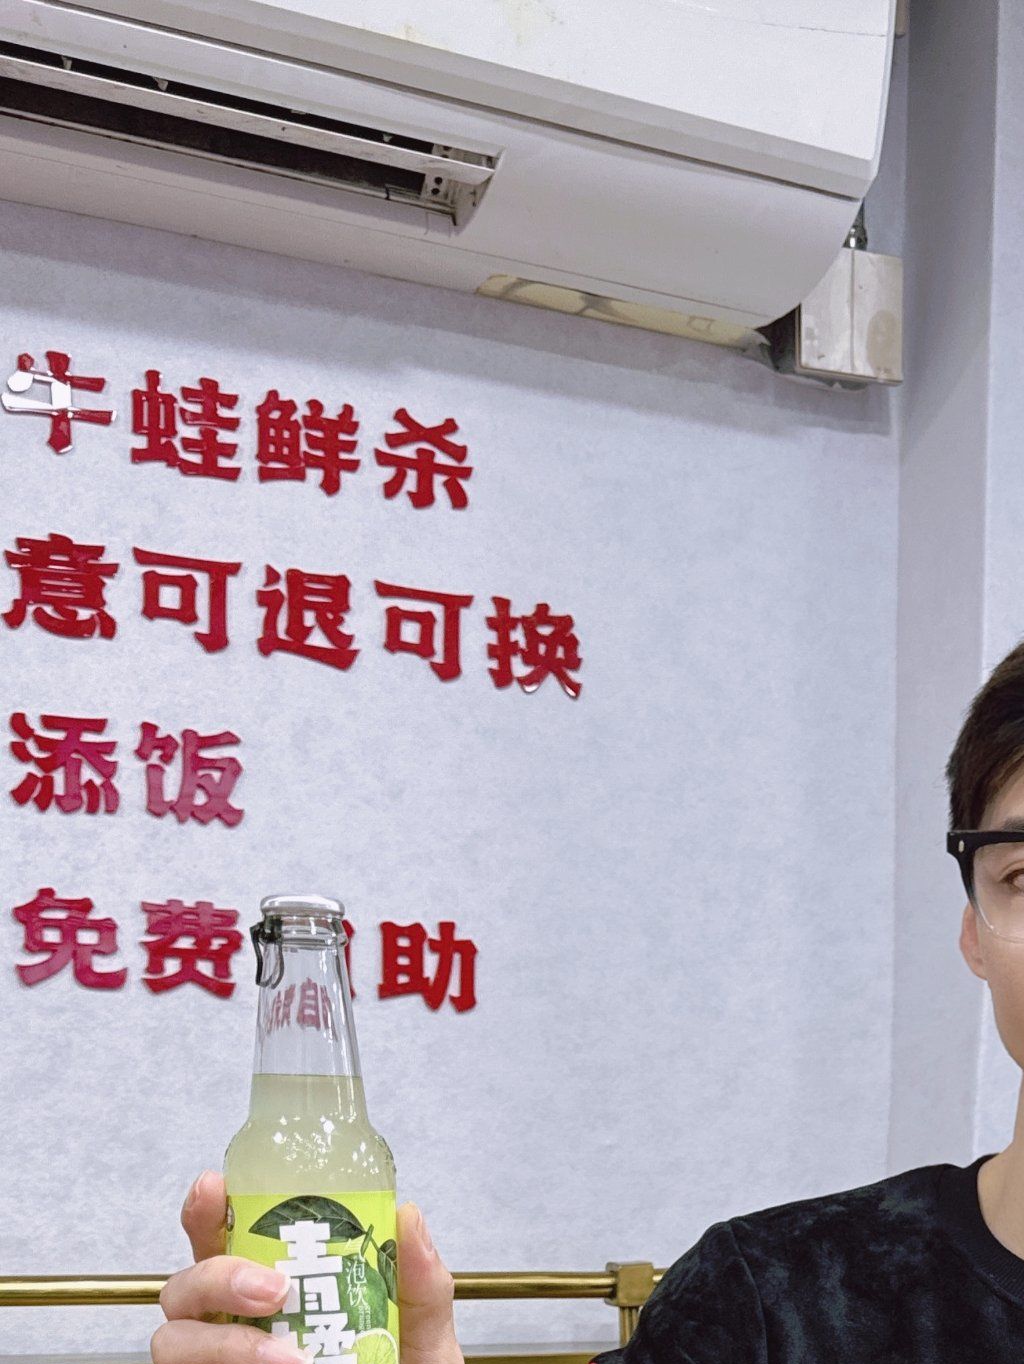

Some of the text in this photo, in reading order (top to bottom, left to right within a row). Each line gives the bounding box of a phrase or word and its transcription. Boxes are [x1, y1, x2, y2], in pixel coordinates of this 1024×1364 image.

[1, 350, 473, 509] 牛蛙鲜杀
[2, 534, 583, 698] 意可退可换
[10, 712, 245, 828] 添饭
[12, 887, 479, 1013] 免费助
